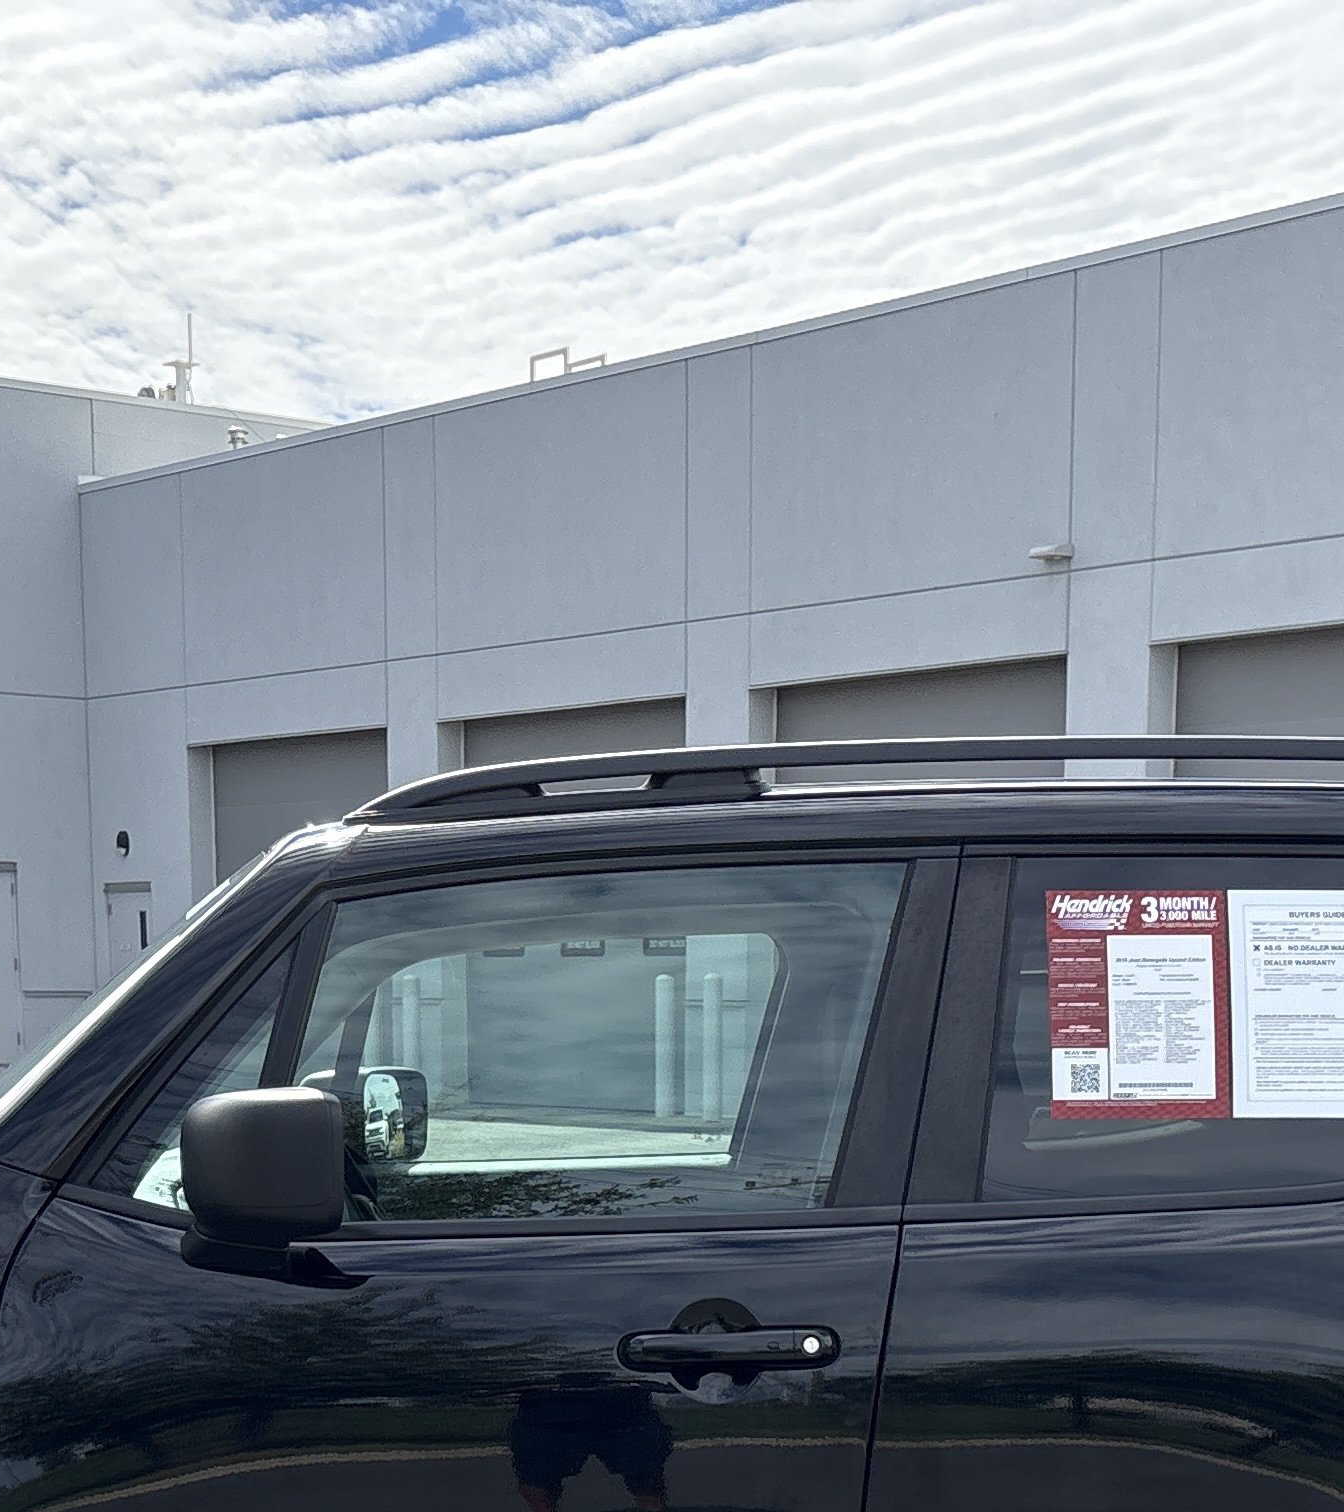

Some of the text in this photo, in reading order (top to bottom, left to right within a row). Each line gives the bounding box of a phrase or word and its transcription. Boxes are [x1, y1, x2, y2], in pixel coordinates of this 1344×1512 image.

[1051, 894, 1133, 919] Hendrick
[1140, 896, 1218, 923] 3 MONTH/
[1191, 910, 1218, 921] MILE
[1288, 911, 1321, 919] BUYERS
